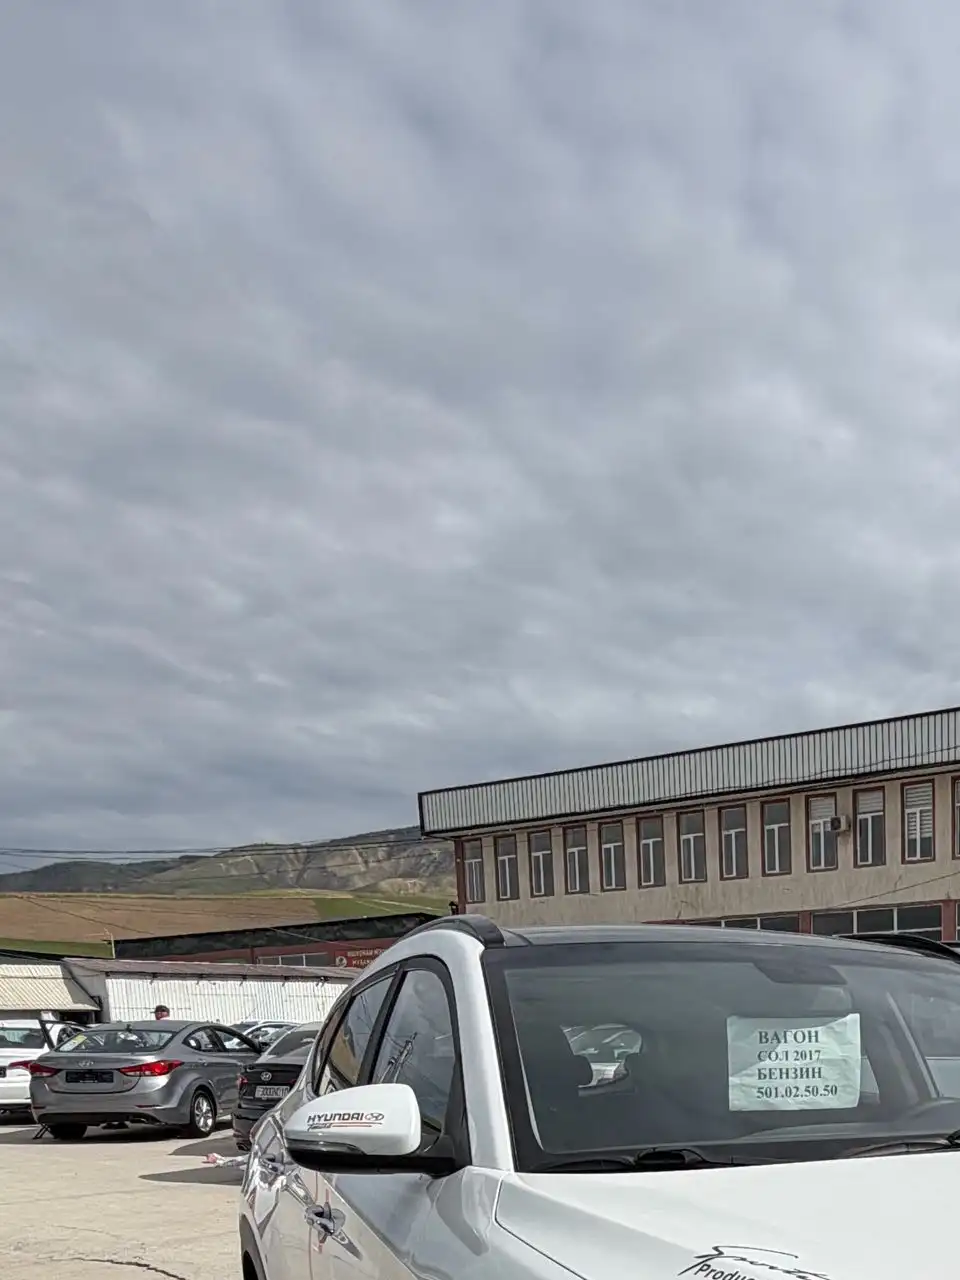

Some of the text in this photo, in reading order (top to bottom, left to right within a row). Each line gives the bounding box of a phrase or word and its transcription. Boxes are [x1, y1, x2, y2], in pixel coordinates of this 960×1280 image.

[758, 1030, 820, 1044] ВАГОН
[757, 1050, 821, 1061] СОЛ 2017
[757, 1067, 822, 1080] БЕНЗИН
[756, 1085, 838, 1099] 501.02.50.50
[307, 1112, 365, 1124] HYUNDAI
